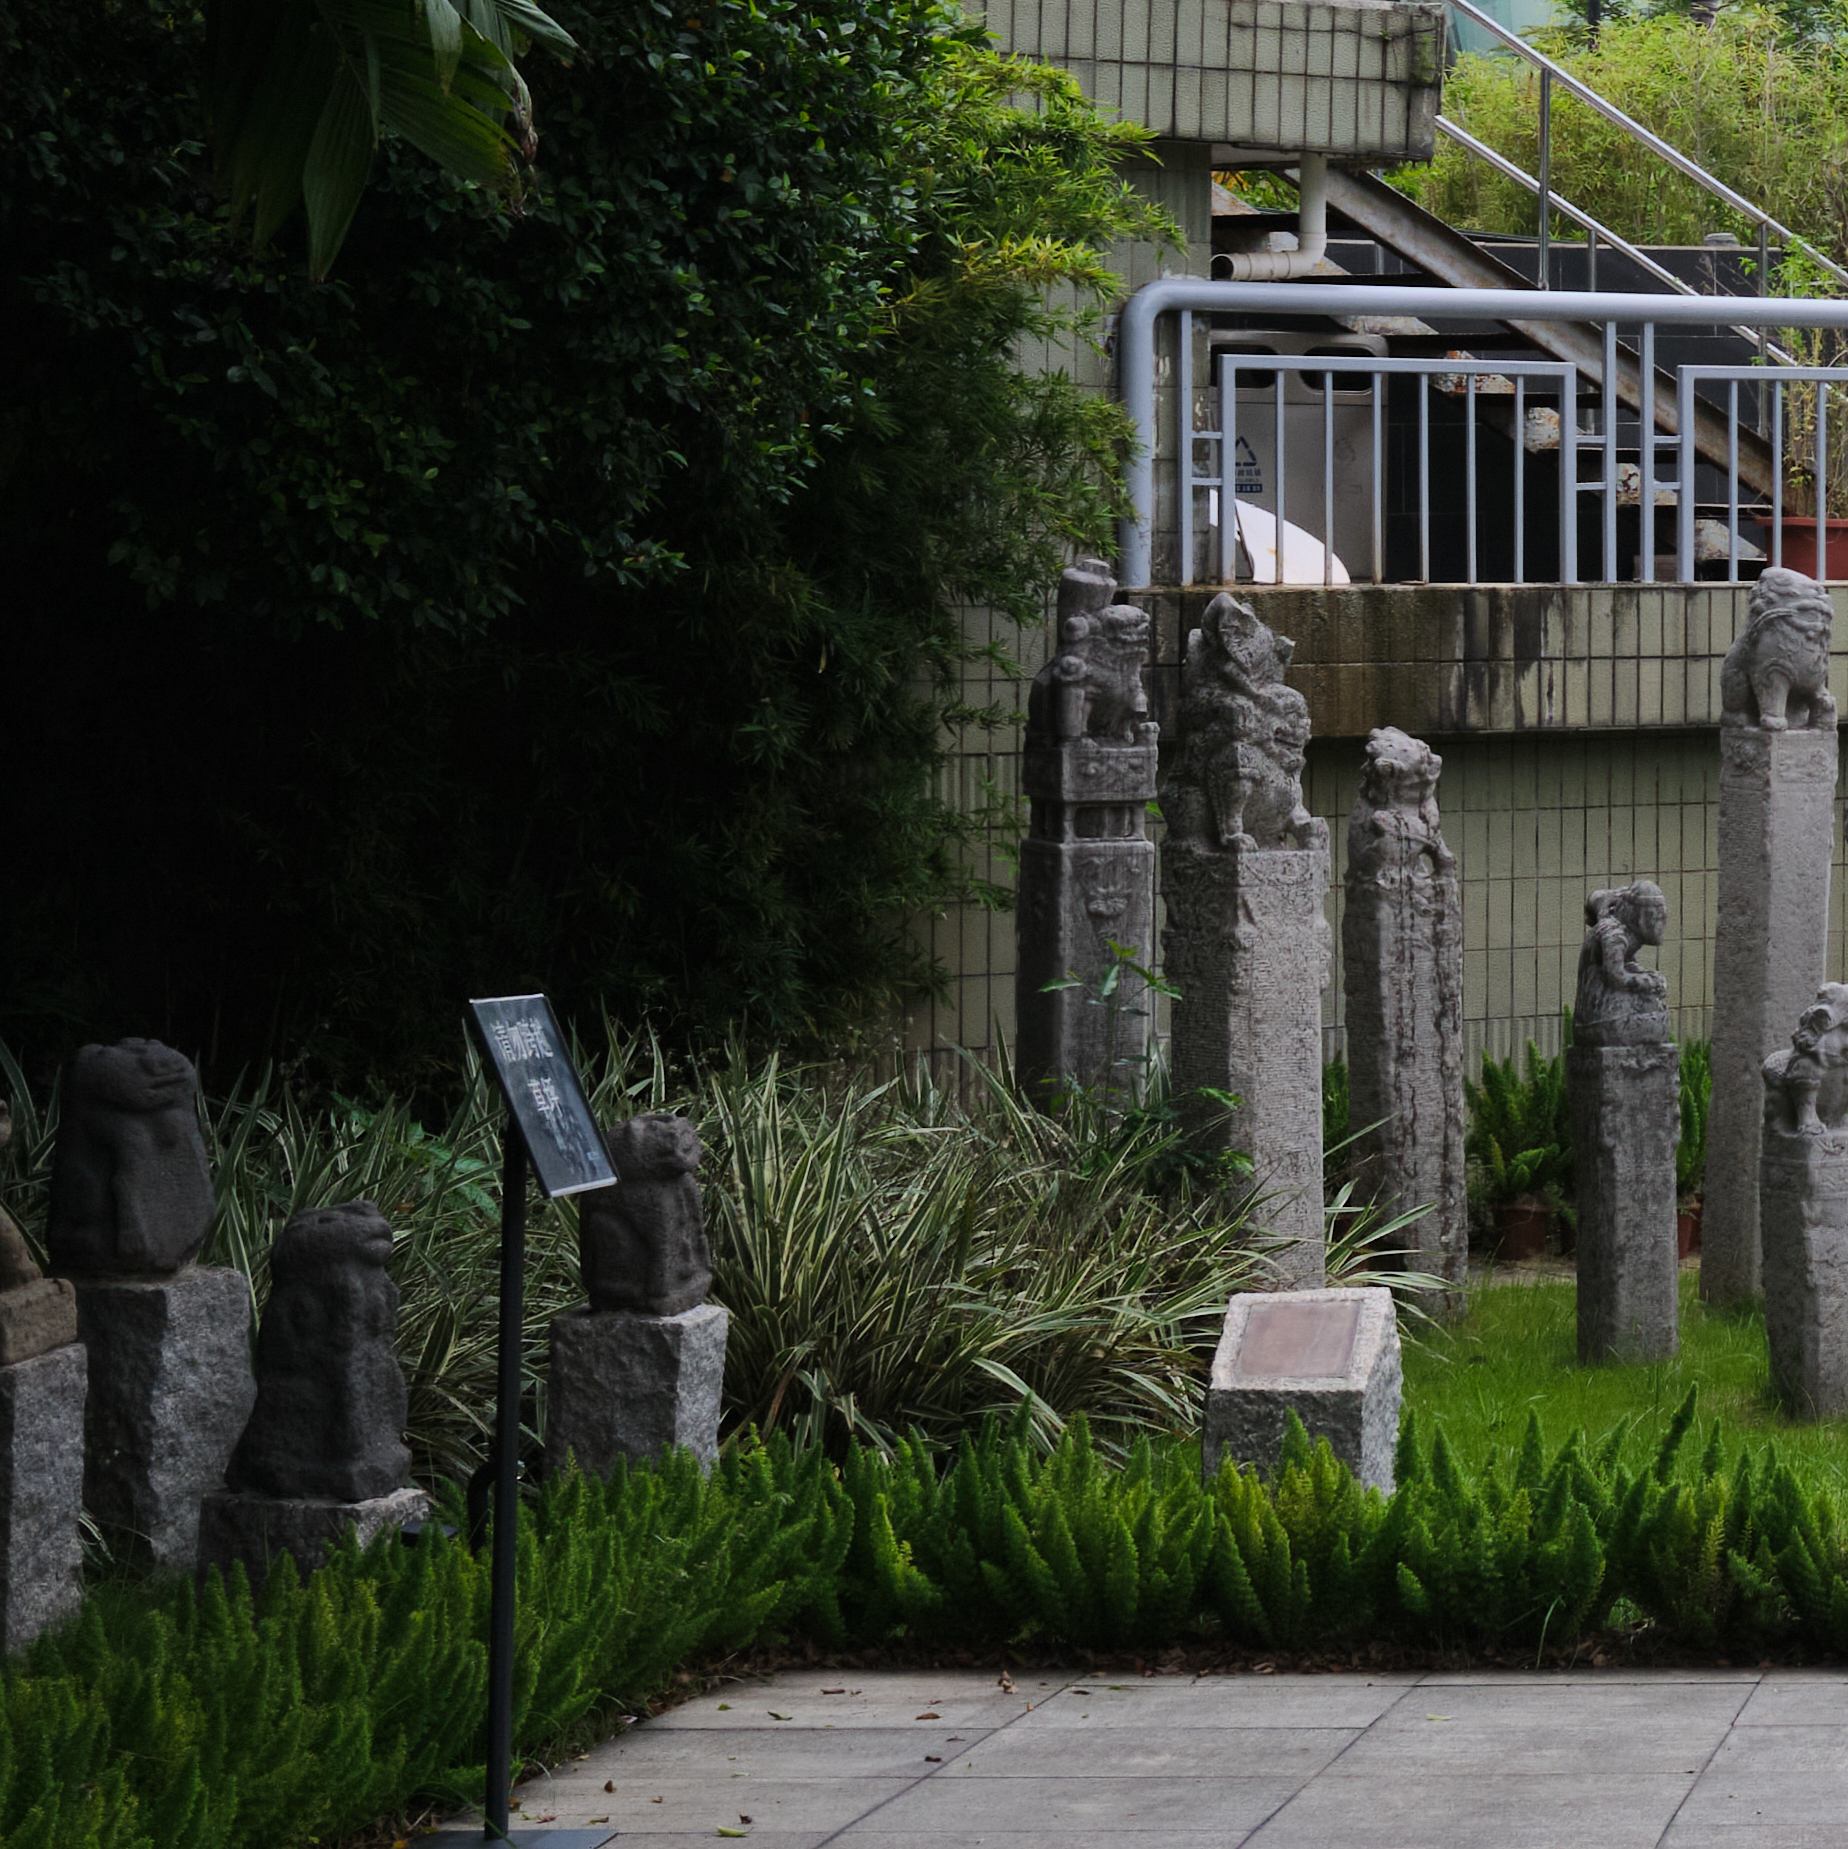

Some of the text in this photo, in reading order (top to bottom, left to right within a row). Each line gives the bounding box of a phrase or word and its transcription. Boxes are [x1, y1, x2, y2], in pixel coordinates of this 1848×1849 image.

[489, 1016, 554, 1064] 请勿跨越
[526, 1076, 562, 1121] 草坪
